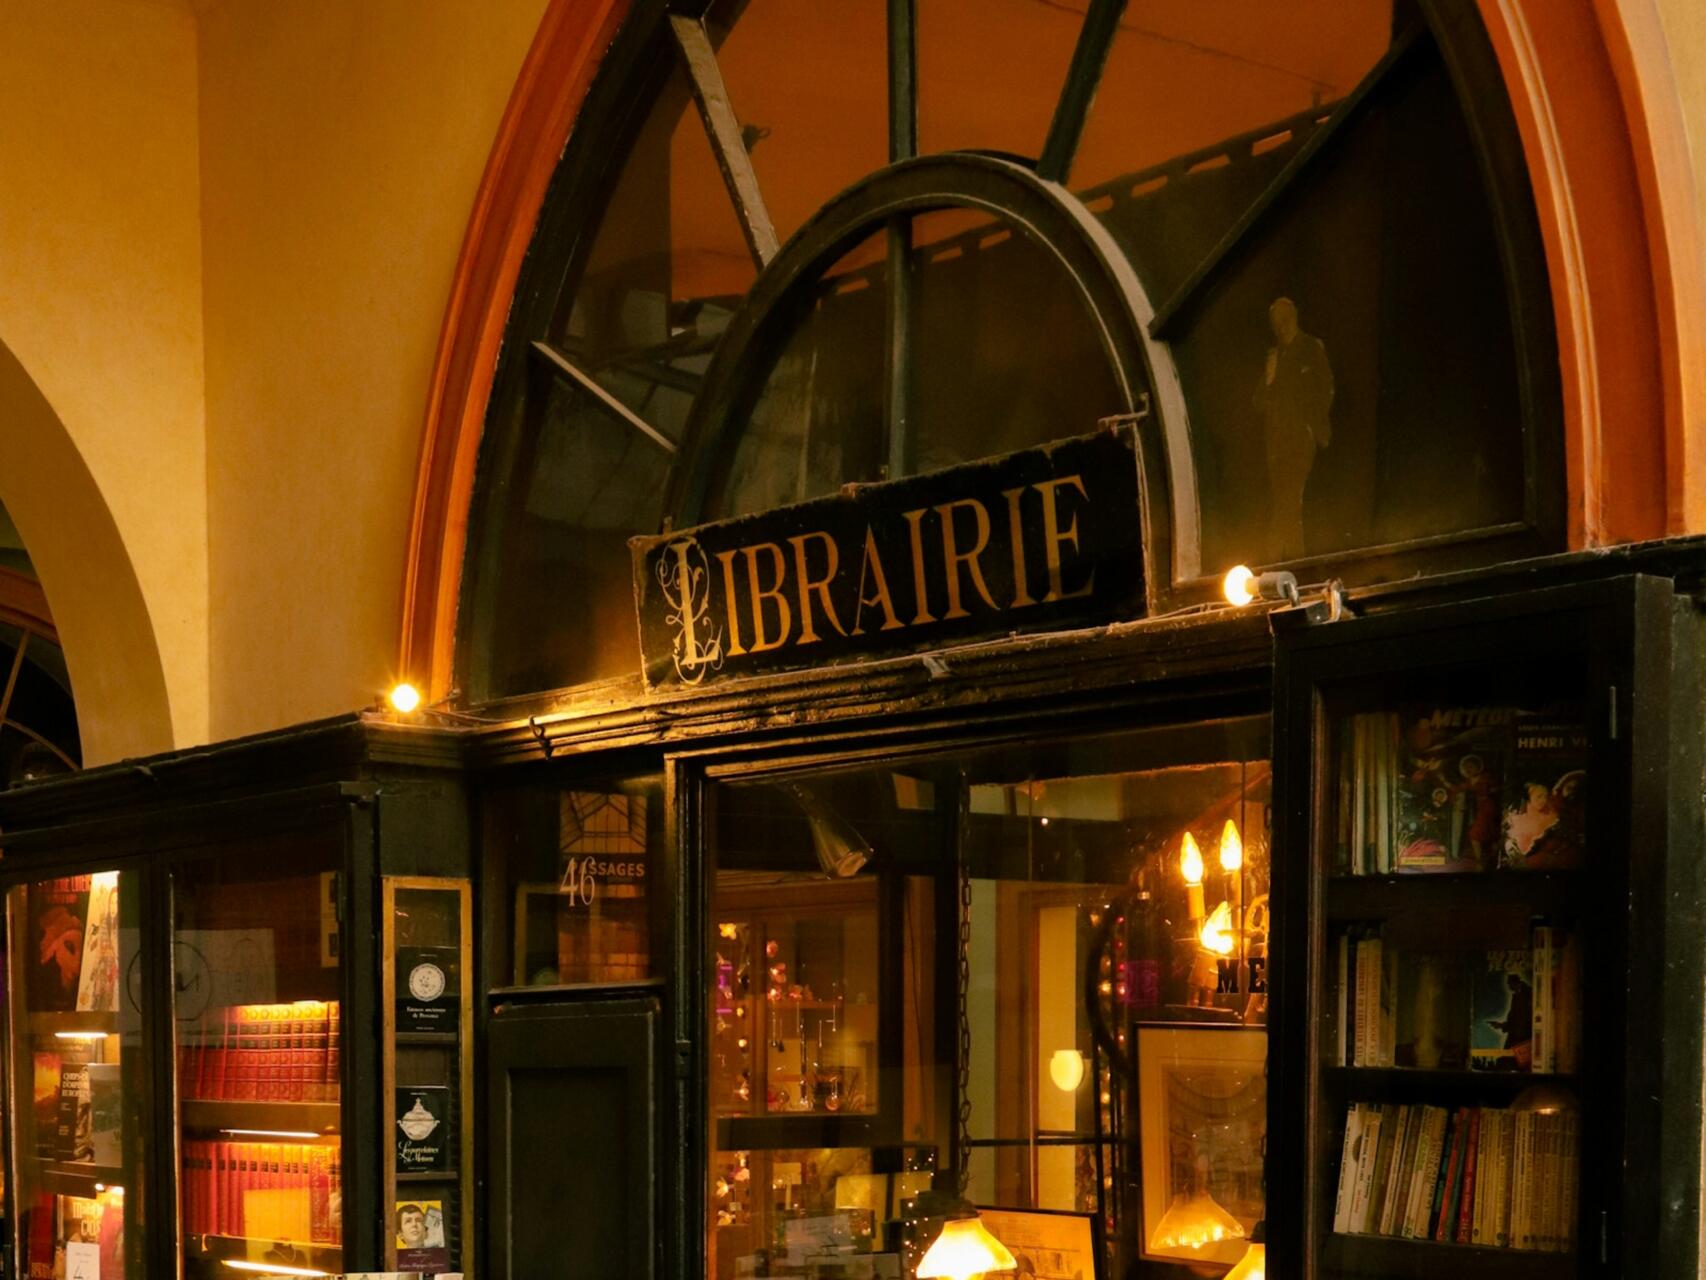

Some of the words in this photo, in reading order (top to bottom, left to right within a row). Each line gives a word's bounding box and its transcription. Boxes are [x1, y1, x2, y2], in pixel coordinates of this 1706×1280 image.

[656, 475, 1096, 685] LIBRAIRIE
[1518, 737, 1564, 749] HENRI
[560, 856, 595, 907] 46
